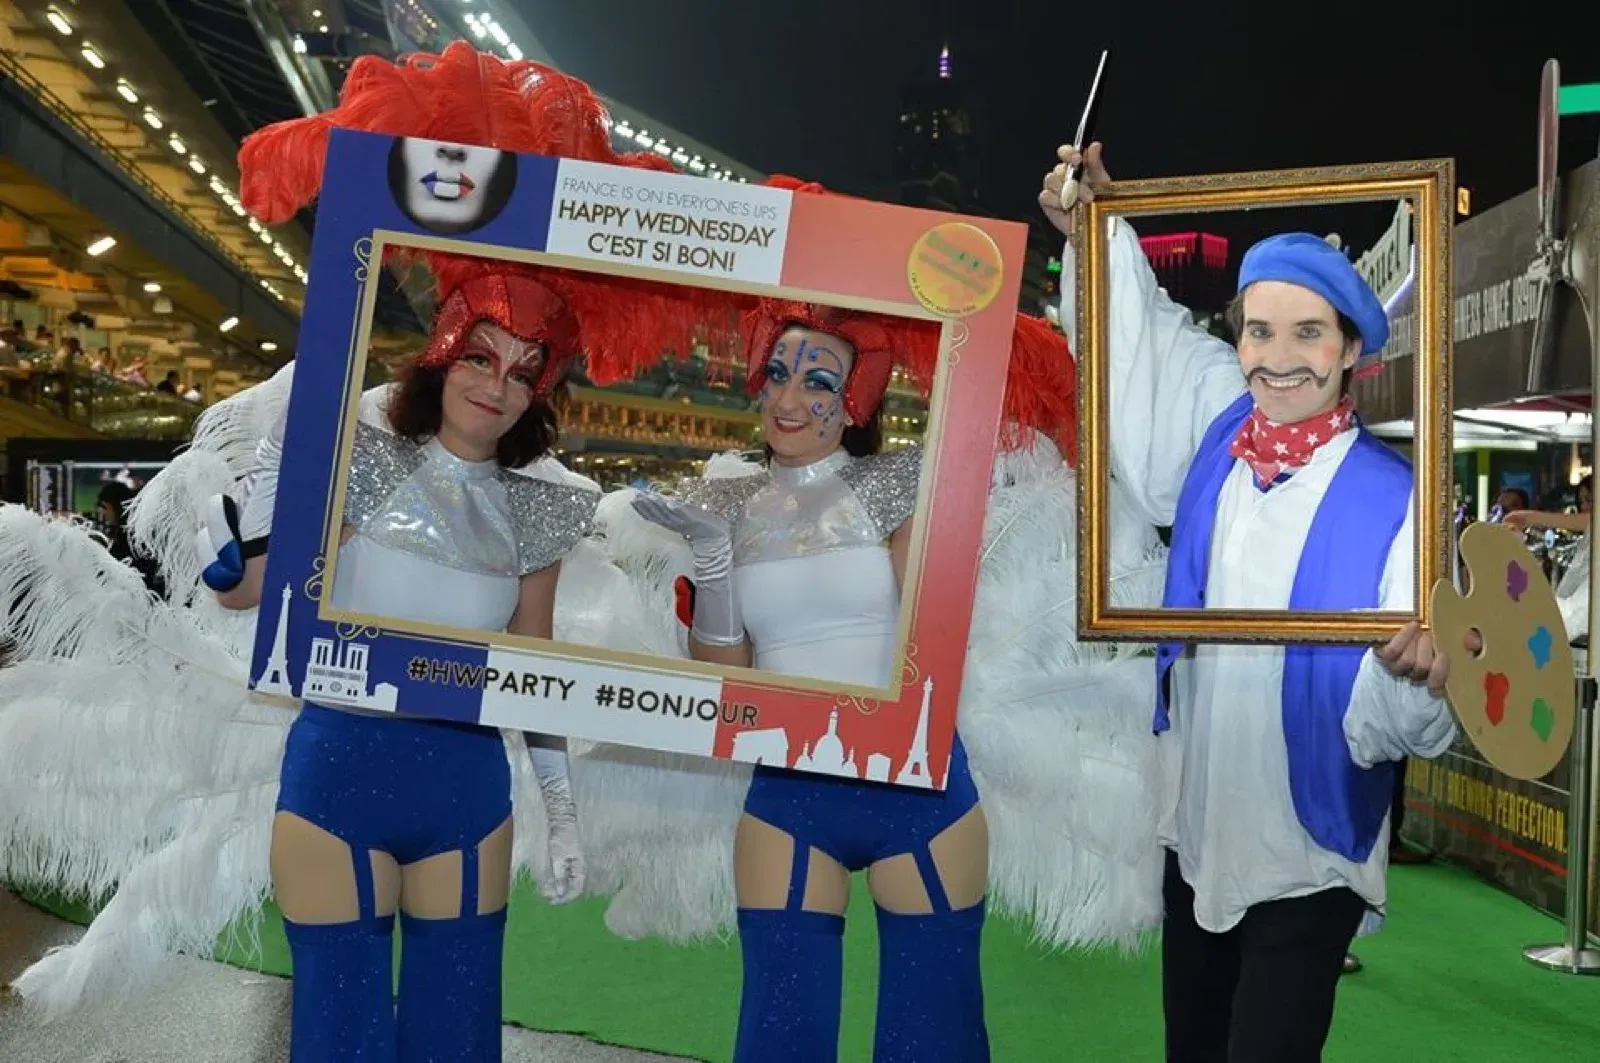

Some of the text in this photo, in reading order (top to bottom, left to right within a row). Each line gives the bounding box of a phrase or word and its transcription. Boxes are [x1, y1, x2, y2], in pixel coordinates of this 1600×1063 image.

[562, 177, 619, 197] FRANCE
[621, 186, 634, 200] IS
[637, 188, 664, 204] ON
[666, 192, 749, 216] EVERYONE'S
[558, 199, 776, 248] HAPPY WEDNESDAY
[588, 232, 736, 272] C'EST SI BON!
[408, 656, 758, 727] #HWPARTY #BONJOUR
